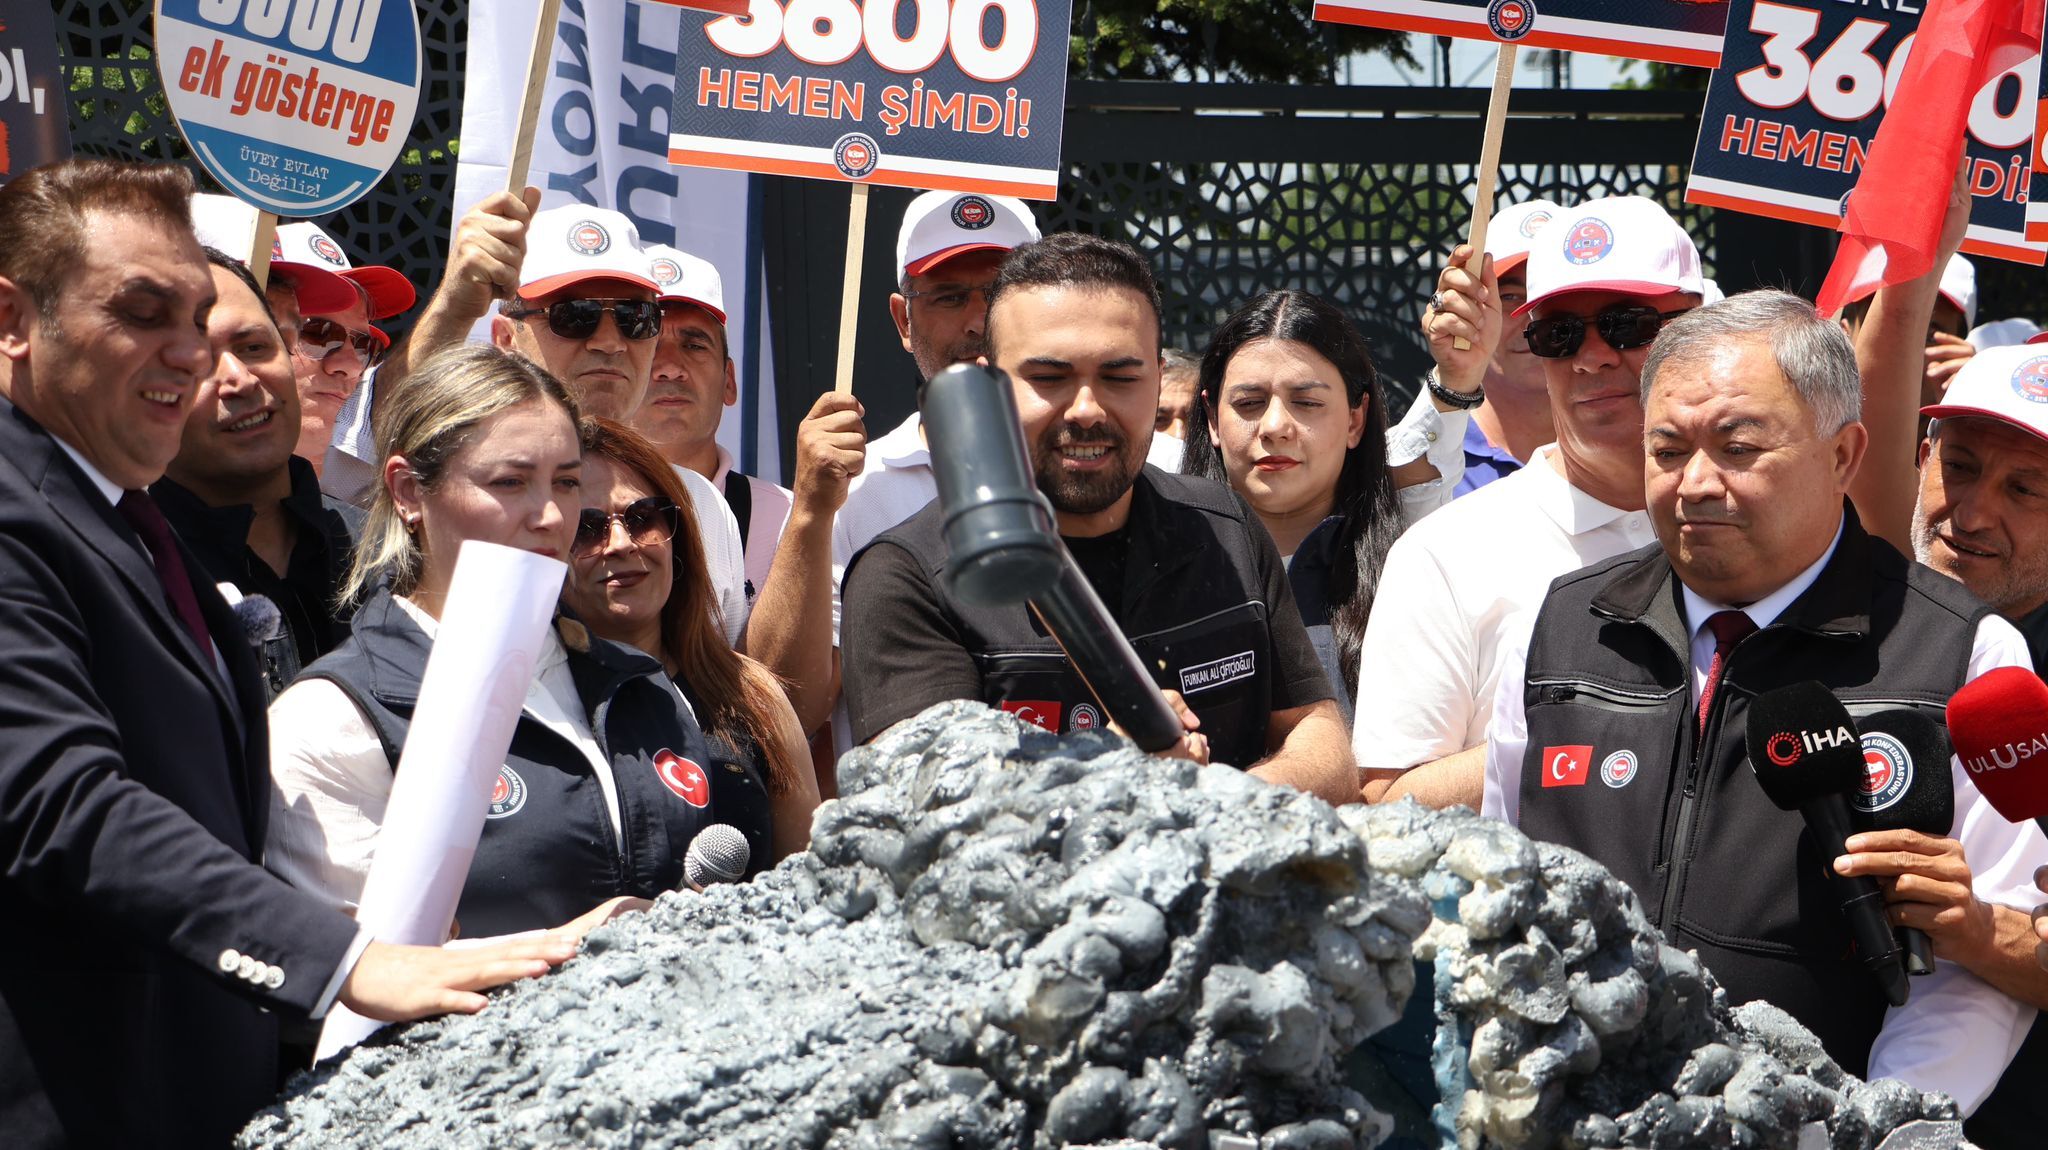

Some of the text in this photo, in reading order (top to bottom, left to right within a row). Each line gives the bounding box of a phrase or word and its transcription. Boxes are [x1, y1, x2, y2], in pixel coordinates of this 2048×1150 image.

[179, 38, 395, 147] ek gösterge
[697, 67, 1032, 139] HEMEN ŞİMDİ!
[241, 145, 329, 181] ÜVEY EVLAT
[248, 167, 320, 198] Değiliz!
[1184, 656, 1251, 687] FURKAN ALİ ÇİFTÇİOĞLU
[1801, 726, 1855, 754] İHA
[1871, 738, 1905, 797] KONFEDERASYONU
